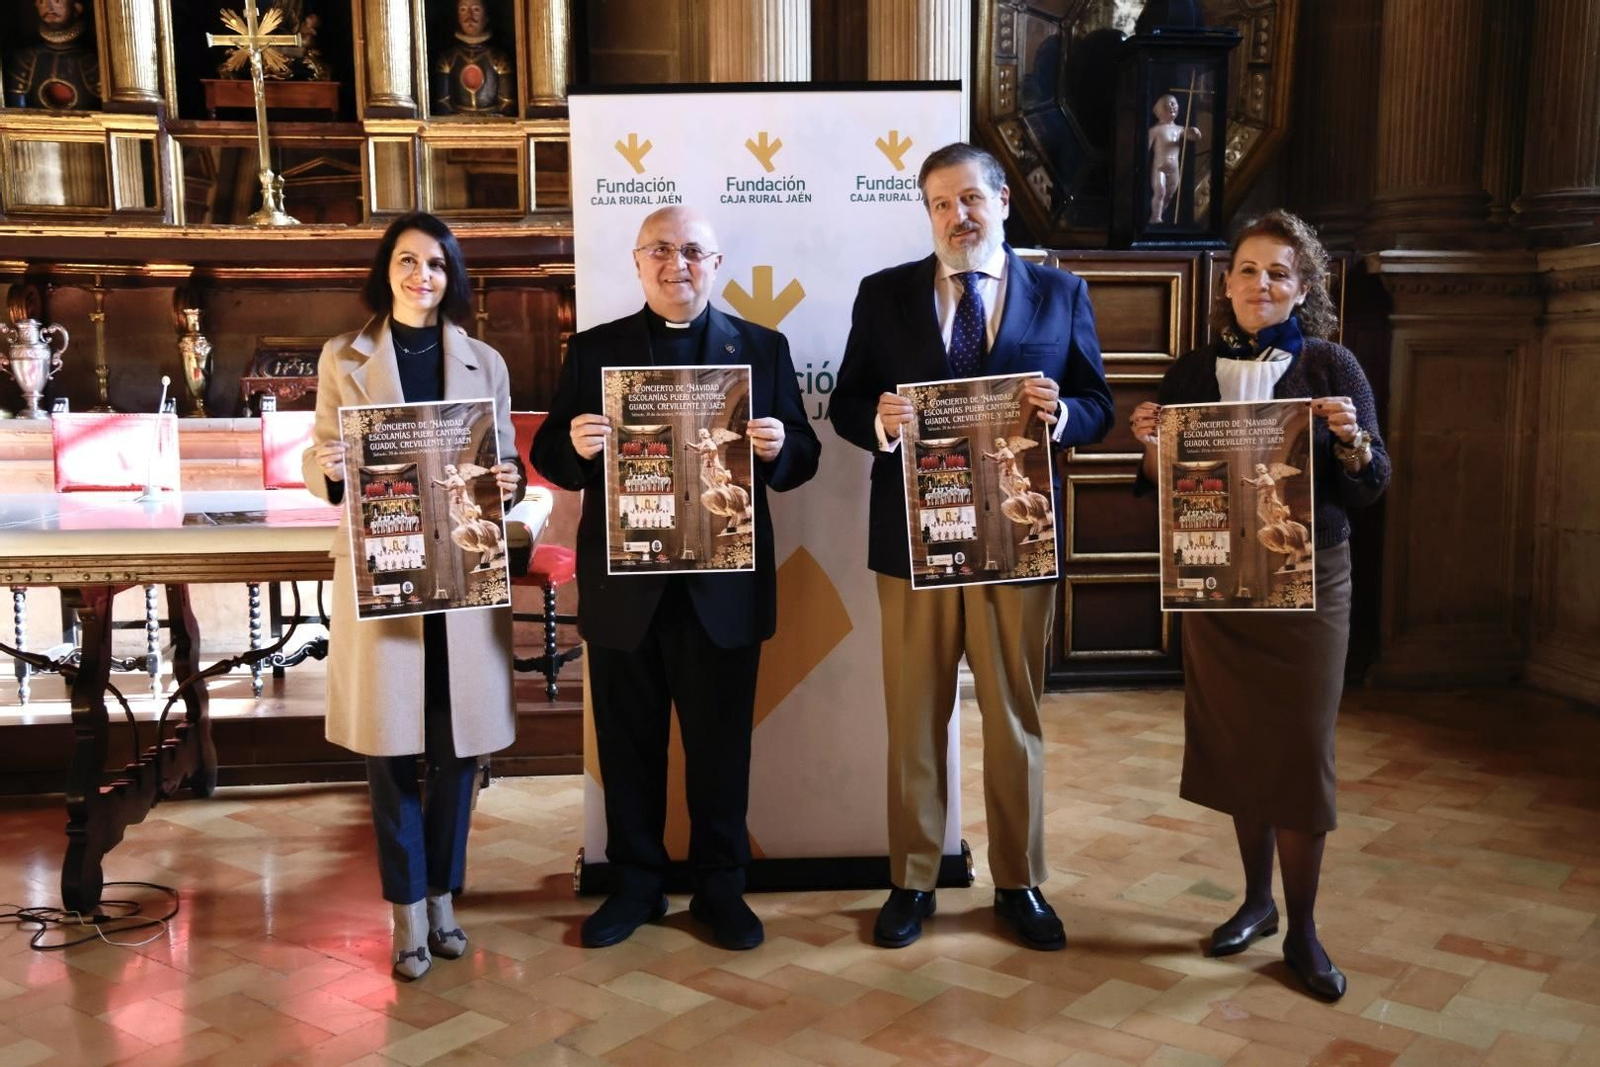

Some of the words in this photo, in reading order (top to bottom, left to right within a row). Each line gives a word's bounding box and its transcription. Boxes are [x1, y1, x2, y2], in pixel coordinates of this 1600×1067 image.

[596, 176, 676, 193] Fundación
[726, 175, 806, 192] Fundación
[856, 174, 917, 190] Fundaci
[590, 196, 617, 206] CAJA
[619, 195, 651, 205] RURAL
[655, 192, 682, 204] JAÉN
[720, 194, 747, 204] CAJA
[749, 194, 782, 203] RURAL
[785, 191, 812, 203] JAÉN
[850, 192, 876, 202] CAJA
[879, 192, 913, 202] RURAL
[675, 384, 684, 392] DE
[691, 393, 726, 401] CANTORES
[986, 402, 1021, 411] CANTORES
[419, 421, 428, 429] DE
[1232, 420, 1240, 428] DE
[435, 428, 472, 437] CANTORES
[1248, 427, 1284, 436] CANTORES
